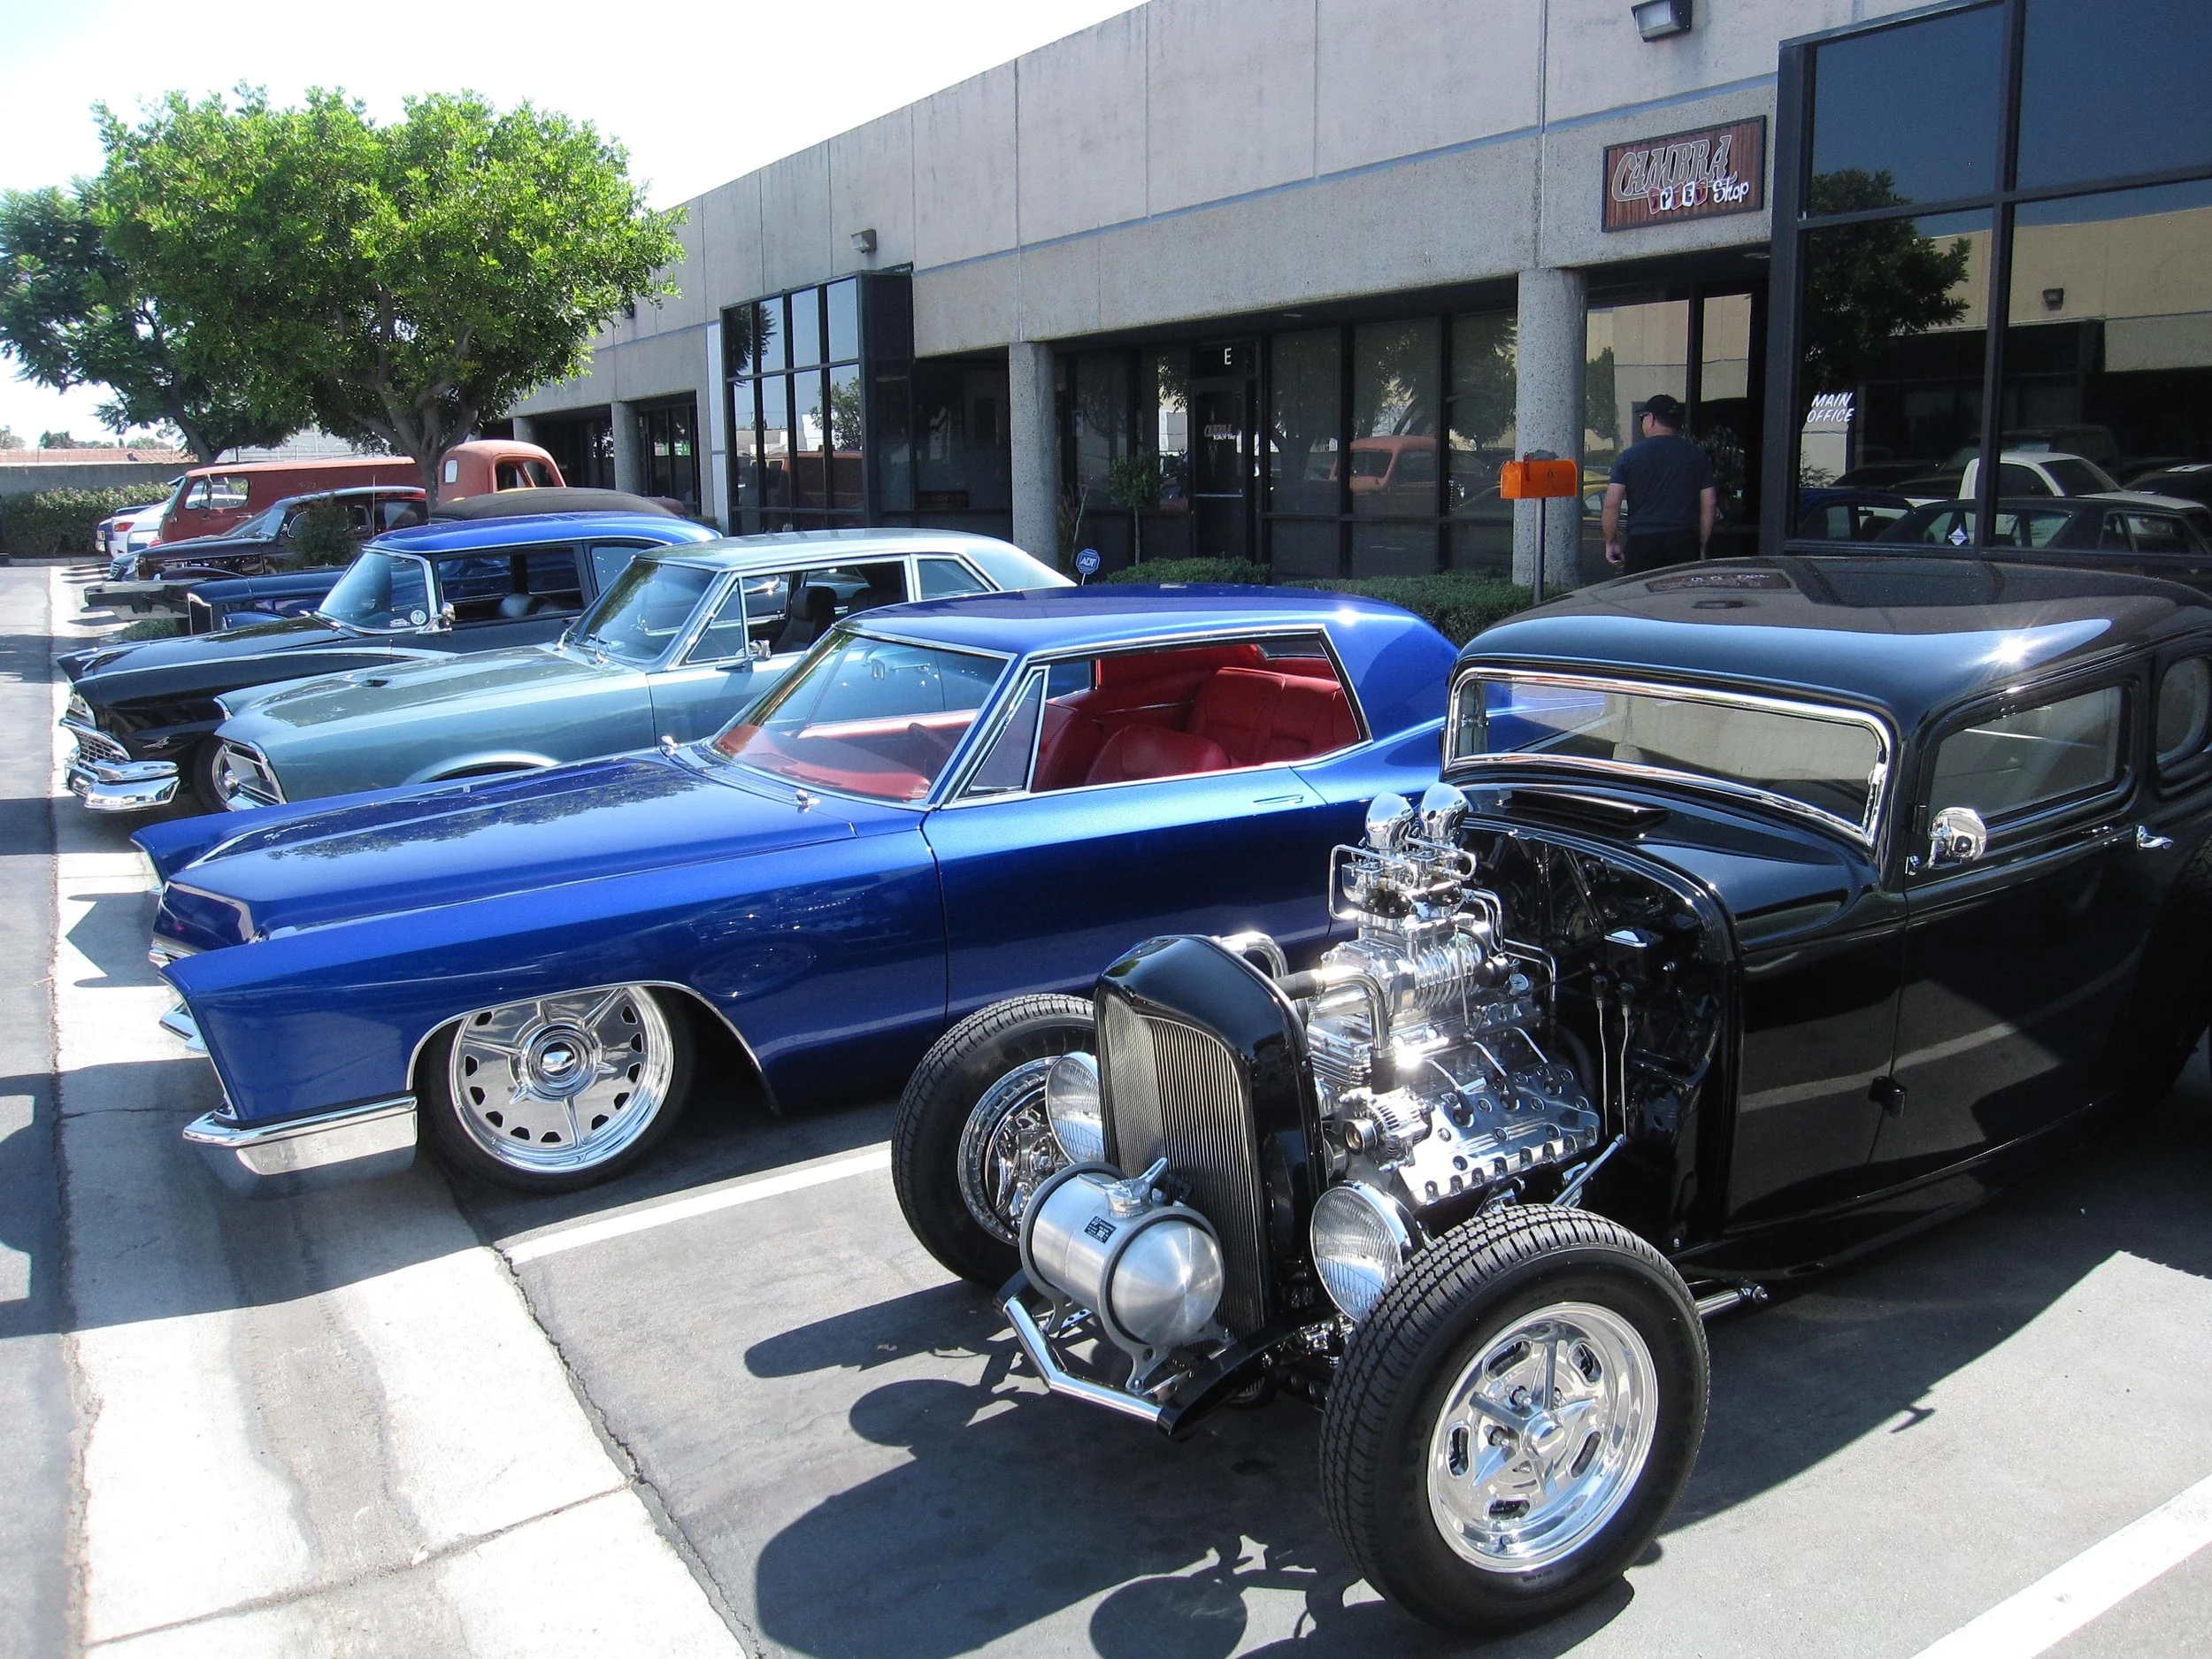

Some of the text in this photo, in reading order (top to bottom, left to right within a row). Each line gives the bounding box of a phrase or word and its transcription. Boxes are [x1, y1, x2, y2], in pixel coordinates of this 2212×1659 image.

[1612, 134, 1737, 202] CAMBRA
[1712, 176, 1749, 204] Shop
[1225, 347, 1232, 365] E
[1811, 392, 1853, 407] MAIN
[1807, 408, 1855, 423] OFFICE
[1079, 557, 1097, 567] ADT
